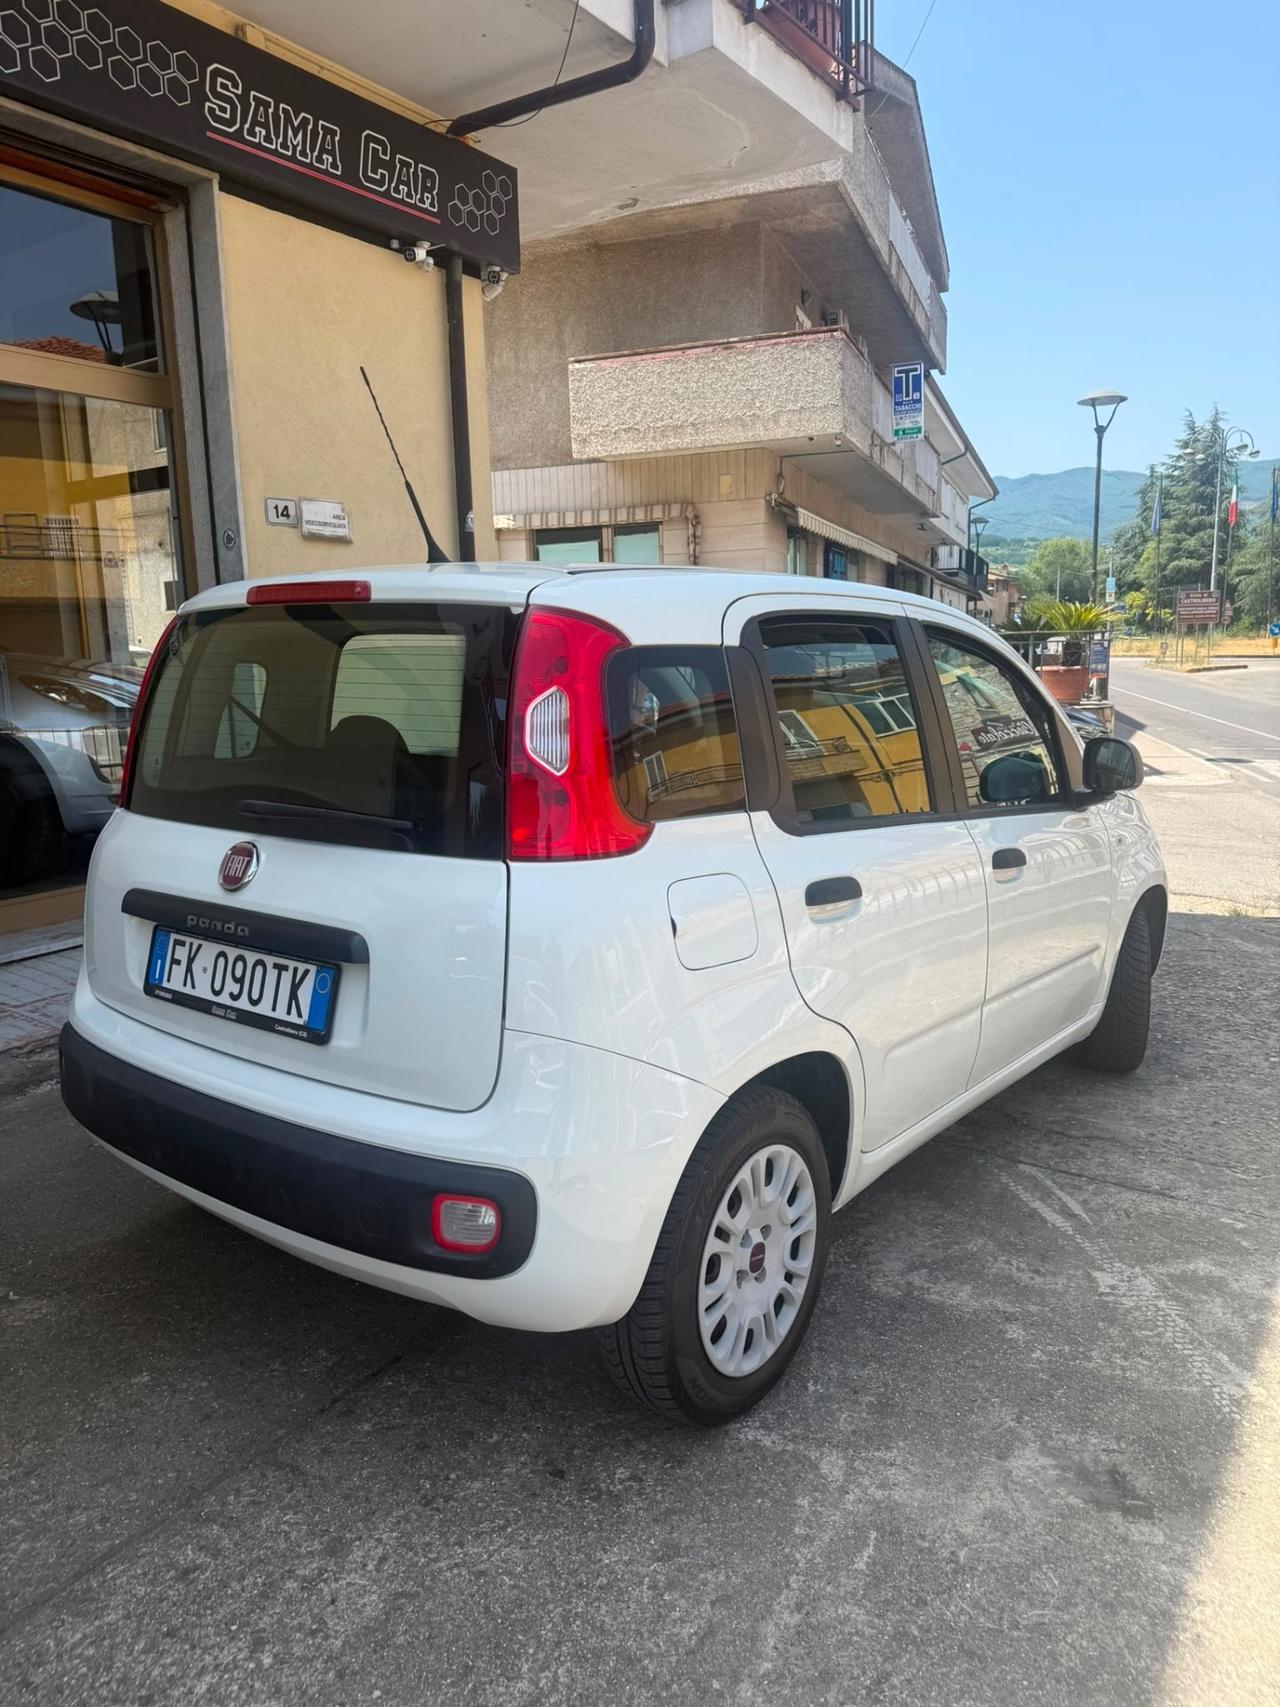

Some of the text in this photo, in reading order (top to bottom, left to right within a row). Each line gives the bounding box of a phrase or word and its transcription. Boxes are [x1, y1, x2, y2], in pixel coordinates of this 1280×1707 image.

[205, 63, 439, 212] SAMA CAR
[895, 364, 921, 401] T
[274, 504, 291, 520] 14
[224, 854, 251, 878] FIAT
[186, 914, 250, 937] panda
[166, 938, 310, 1019] FK 090TK
